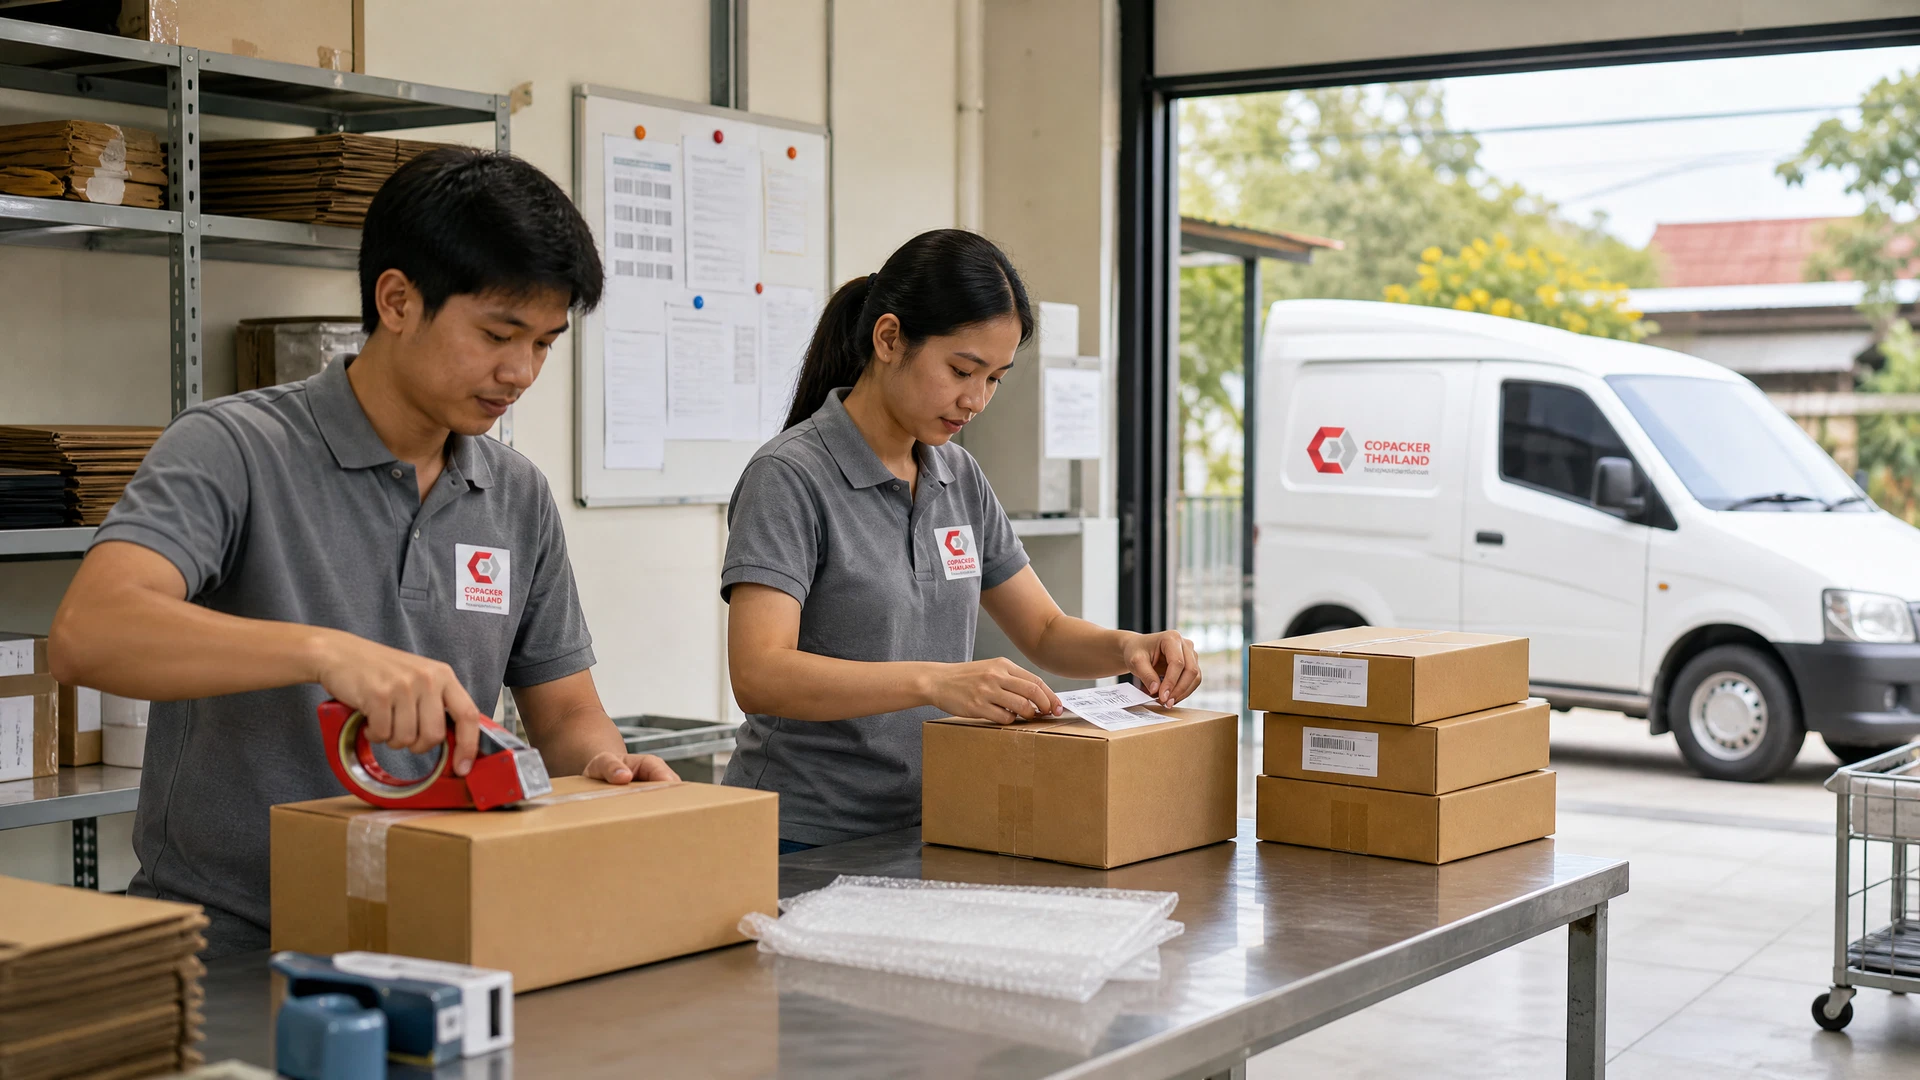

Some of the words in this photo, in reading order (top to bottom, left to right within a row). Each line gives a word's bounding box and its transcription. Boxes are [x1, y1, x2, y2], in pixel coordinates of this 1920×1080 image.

[1364, 440, 1431, 453] COPACKER
[1364, 453, 1430, 466] THAILAND
[947, 558, 975, 566] COPACKER
[464, 586, 503, 596] COPACKER
[465, 594, 502, 604] THAILAND
